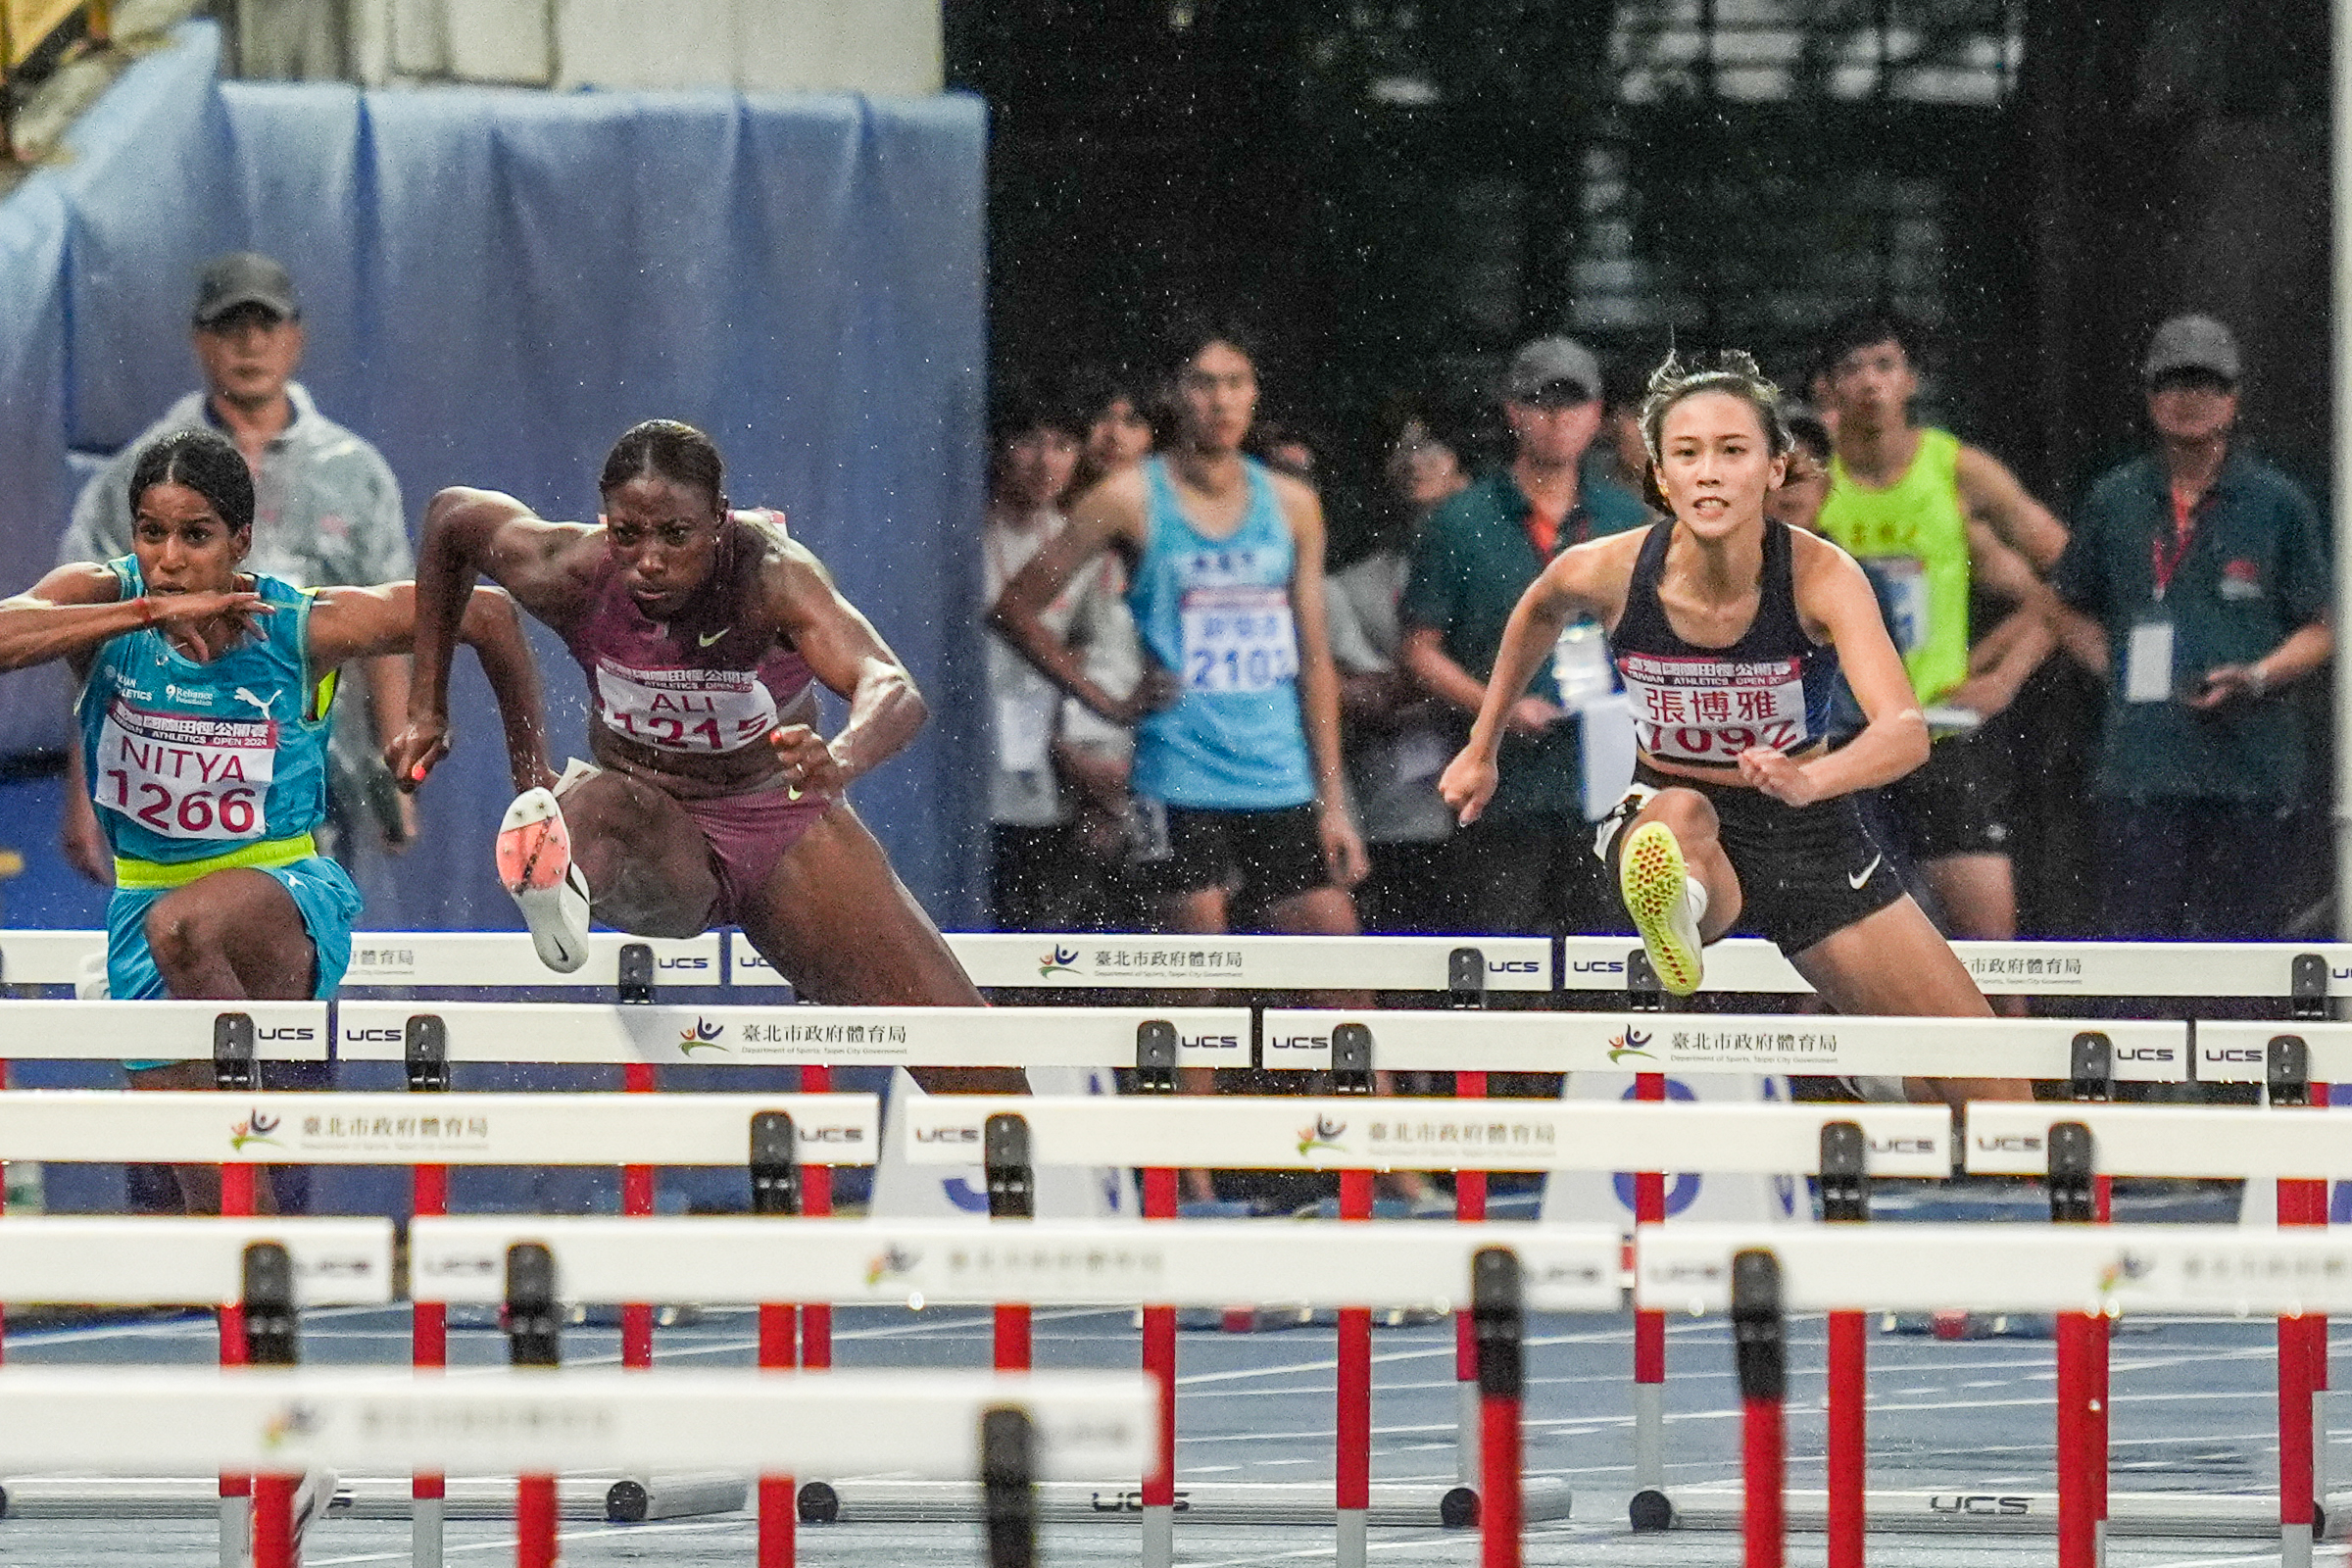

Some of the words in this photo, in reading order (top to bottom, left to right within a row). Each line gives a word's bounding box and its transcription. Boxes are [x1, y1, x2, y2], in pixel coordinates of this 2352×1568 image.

[1673, 676, 1729, 686] ATHLETICS
[1736, 676, 1765, 686] OPEN
[651, 693, 715, 713] ALI
[1644, 687, 1779, 724] 張博雅
[151, 730, 207, 745] ATHLETICS
[212, 736, 242, 747] OPEN
[244, 737, 268, 747] 2024
[613, 711, 768, 751] 1215
[121, 735, 246, 784] NITYA
[107, 768, 256, 833] 1266
[659, 957, 710, 969] UCS
[740, 956, 772, 967] UC
[1095, 950, 1243, 968] 臺北市政府體育局
[1489, 961, 1541, 972] UCS
[1574, 961, 1625, 972] UCS
[259, 1028, 315, 1040] UCS
[347, 1029, 403, 1041] UCS
[742, 1024, 906, 1044] 臺北市政府體育局
[1182, 1036, 1238, 1049] UCS
[1273, 1037, 1329, 1050] UCS
[1671, 1031, 1838, 1053] 臺北市政府體育局
[2118, 1048, 2175, 1061] UCS
[2206, 1049, 2264, 1062] UCS
[800, 1128, 863, 1144] UCS
[916, 1128, 979, 1143] UCS
[1871, 1139, 1936, 1153] UCS
[1978, 1137, 2042, 1152] UCS
[1931, 1495, 2034, 1515] UCS
